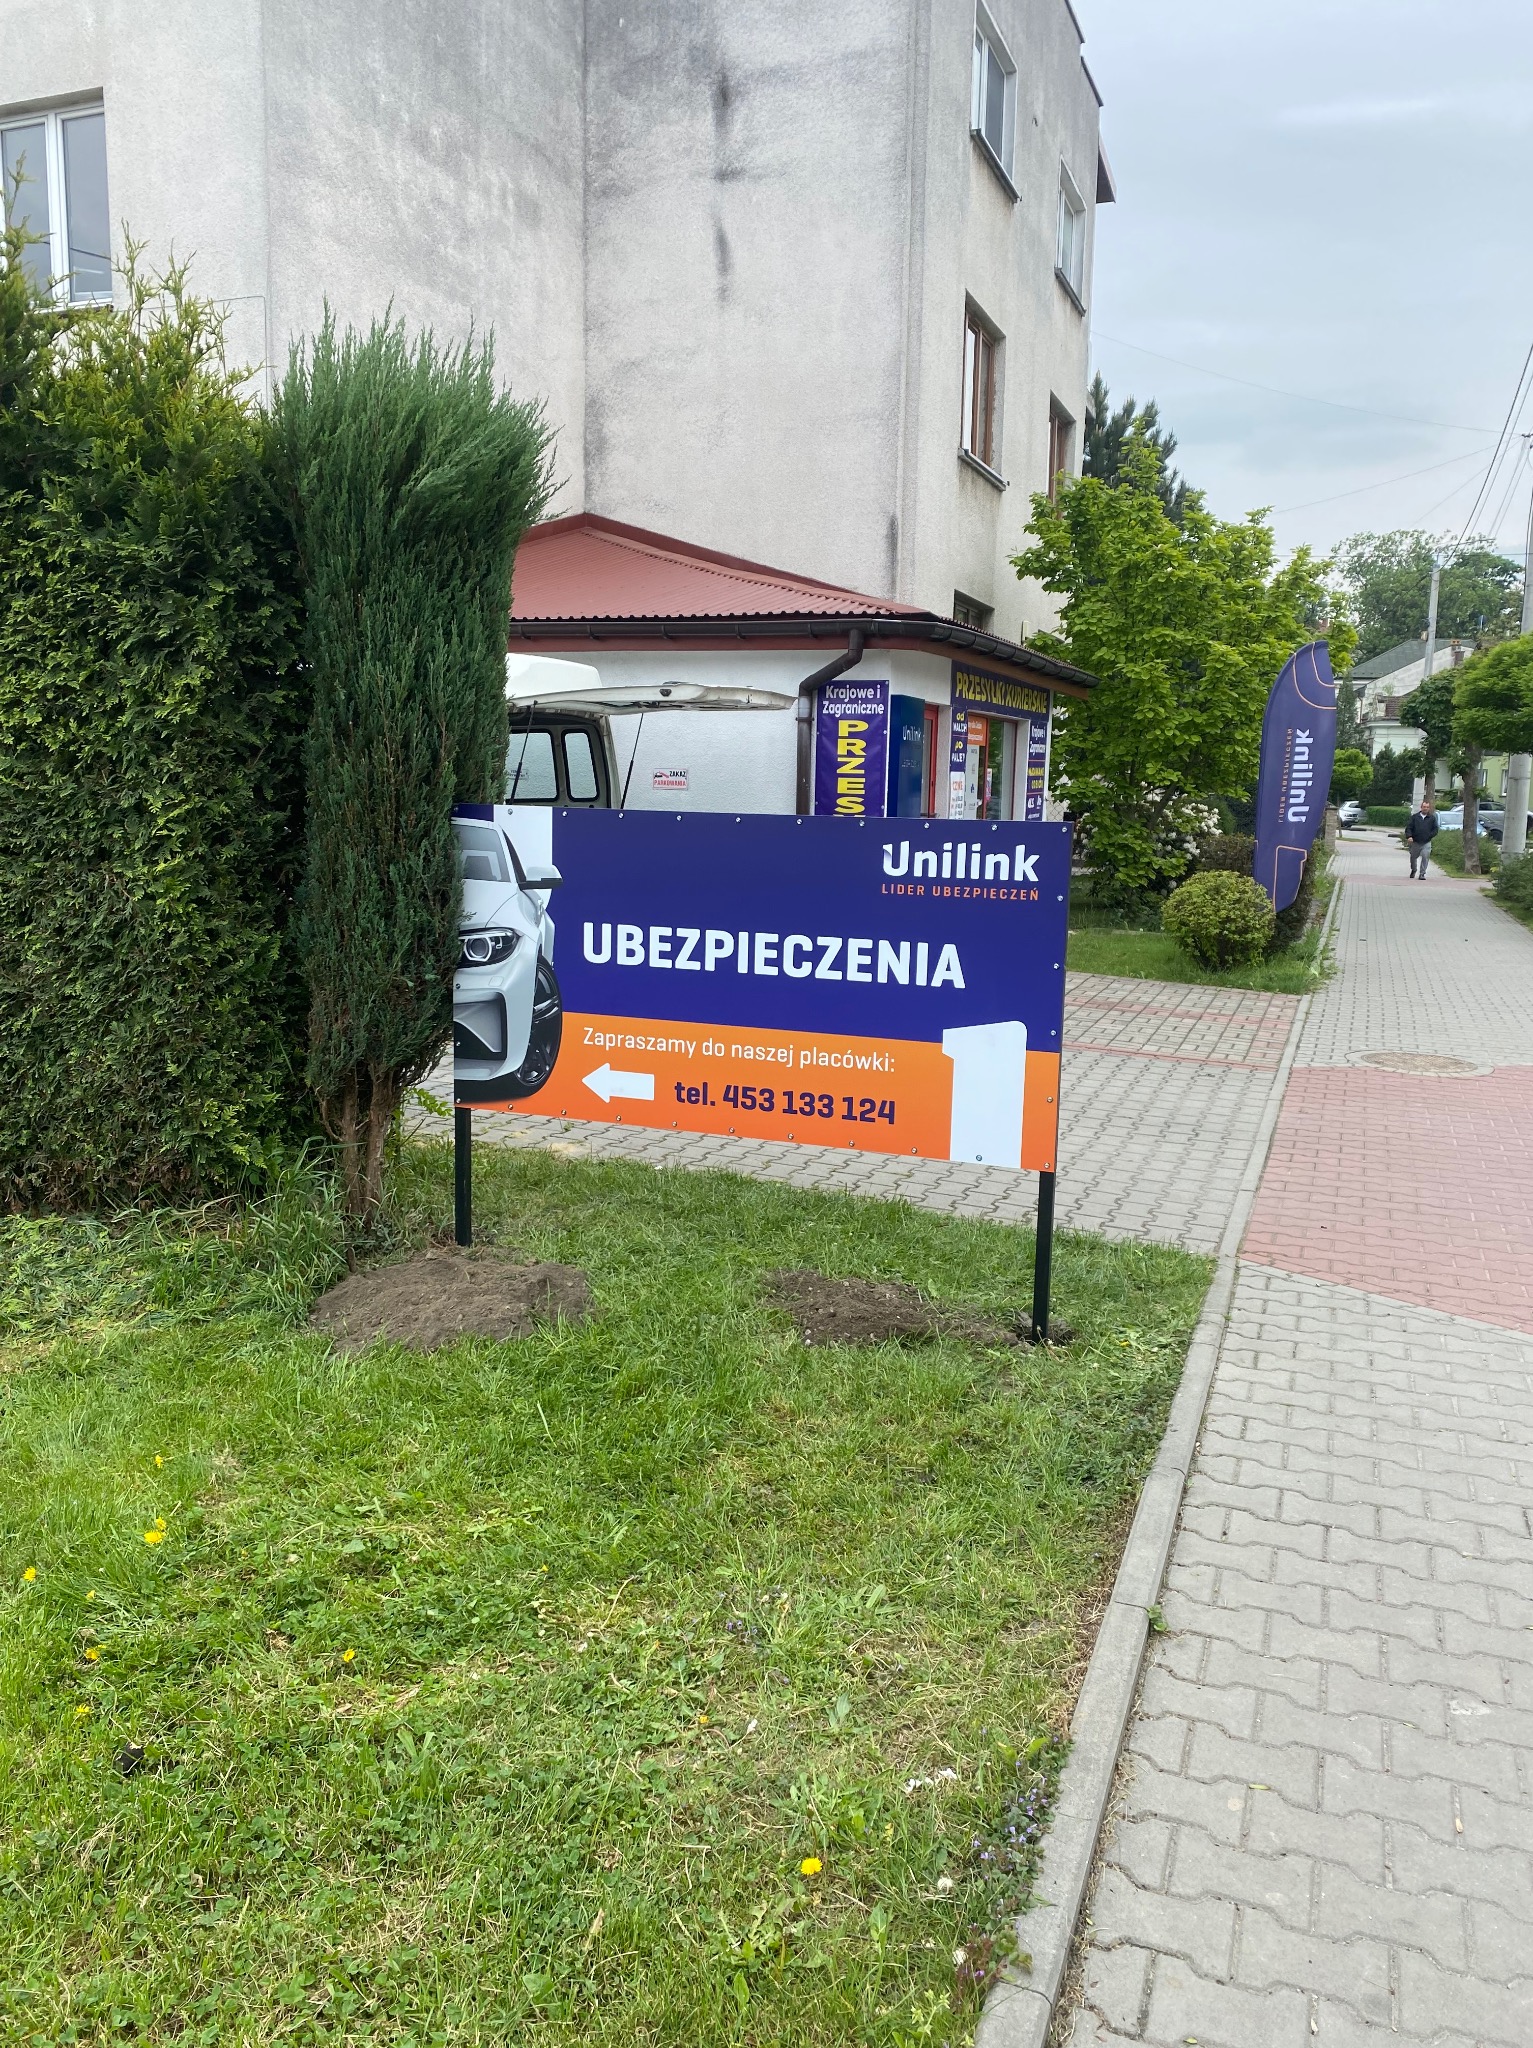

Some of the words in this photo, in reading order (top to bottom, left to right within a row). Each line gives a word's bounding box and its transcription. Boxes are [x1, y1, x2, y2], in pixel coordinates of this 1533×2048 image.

[822, 700, 885, 718] Zagraniczne
[825, 684, 875, 703] Krajowe
[877, 684, 881, 699] i
[834, 720, 869, 817] PRZES
[882, 840, 1040, 882] Unilink
[882, 883, 925, 896] LIDER
[932, 885, 1039, 901] UBEZPIECZEŃ
[583, 922, 966, 989] UBEZPIECZENIA
[583, 1027, 697, 1058] Zapraszamy
[702, 1037, 725, 1057] do
[731, 1043, 794, 1068] naszej
[800, 1047, 895, 1073] placówki:
[674, 1081, 716, 1107] tel.
[722, 1084, 775, 1112] 453
[782, 1091, 835, 1118] 133
[841, 1096, 896, 1125] 124
